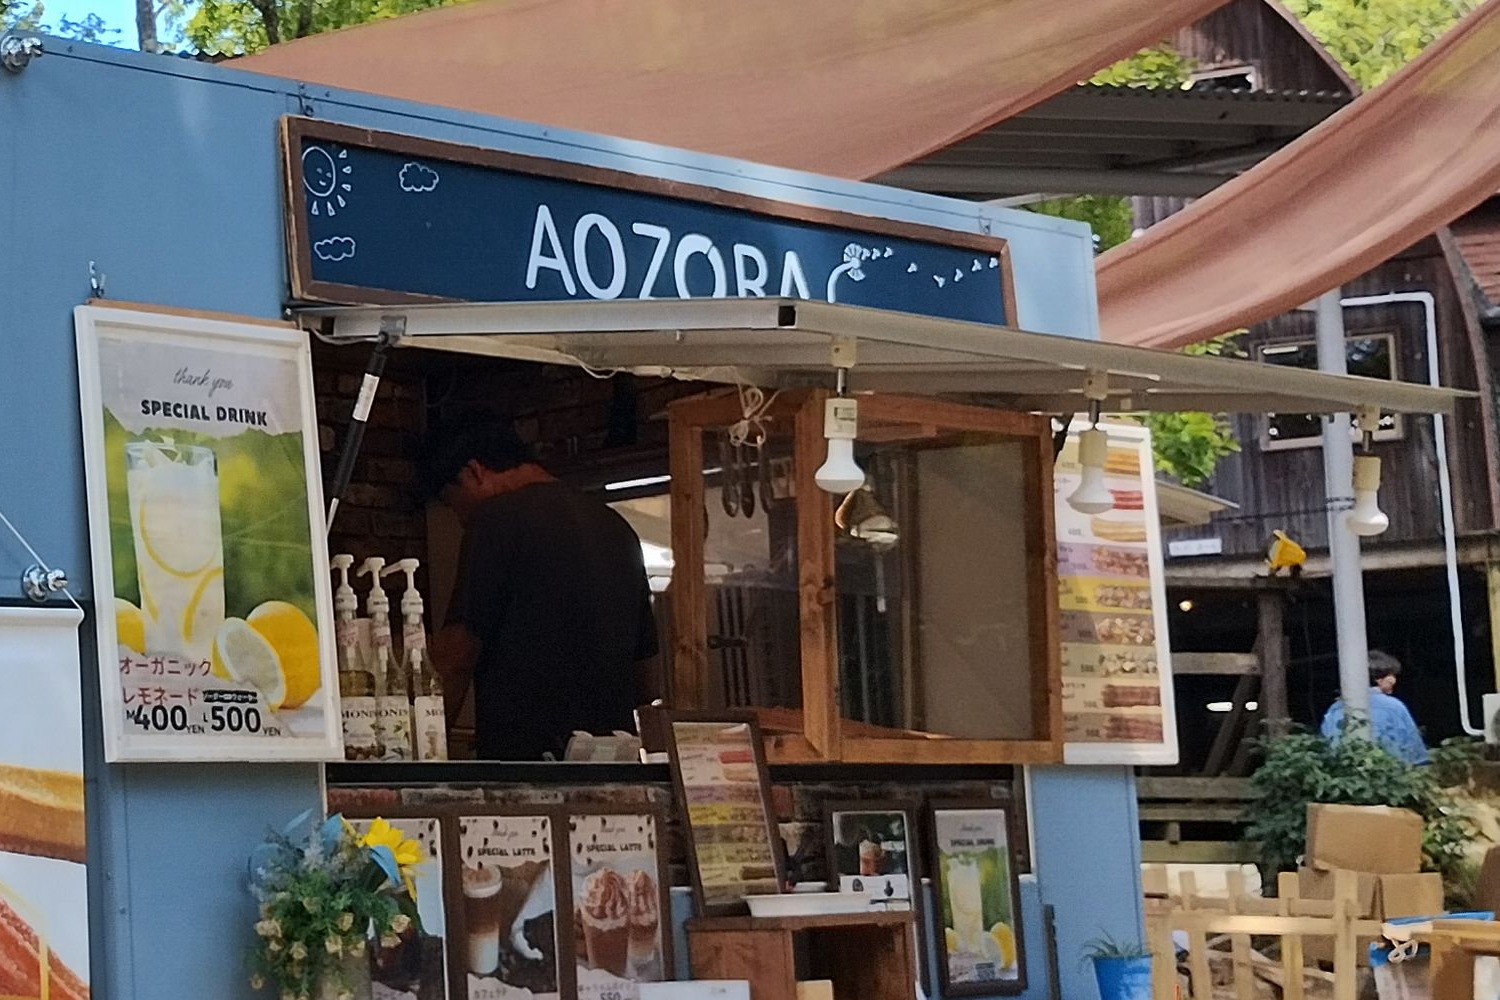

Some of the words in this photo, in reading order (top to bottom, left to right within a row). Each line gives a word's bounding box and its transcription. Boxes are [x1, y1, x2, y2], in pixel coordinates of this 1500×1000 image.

[524, 203, 810, 301] AOZORA
[173, 367, 211, 386] thank
[209, 379, 234, 398] you
[141, 399, 211, 421] SPECIAL
[216, 406, 268, 427] DRINK
[119, 656, 212, 677] オーガニック
[122, 686, 200, 706] レモネード
[134, 704, 187, 731] 400
[186, 726, 205, 735] YEN
[211, 705, 261, 732] 500
[263, 726, 281, 736] YEN
[477, 847, 508, 857] SPECIAL
[512, 847, 536, 857] LATTE
[586, 844, 617, 853] SPECIAL
[620, 842, 643, 852] LATTE
